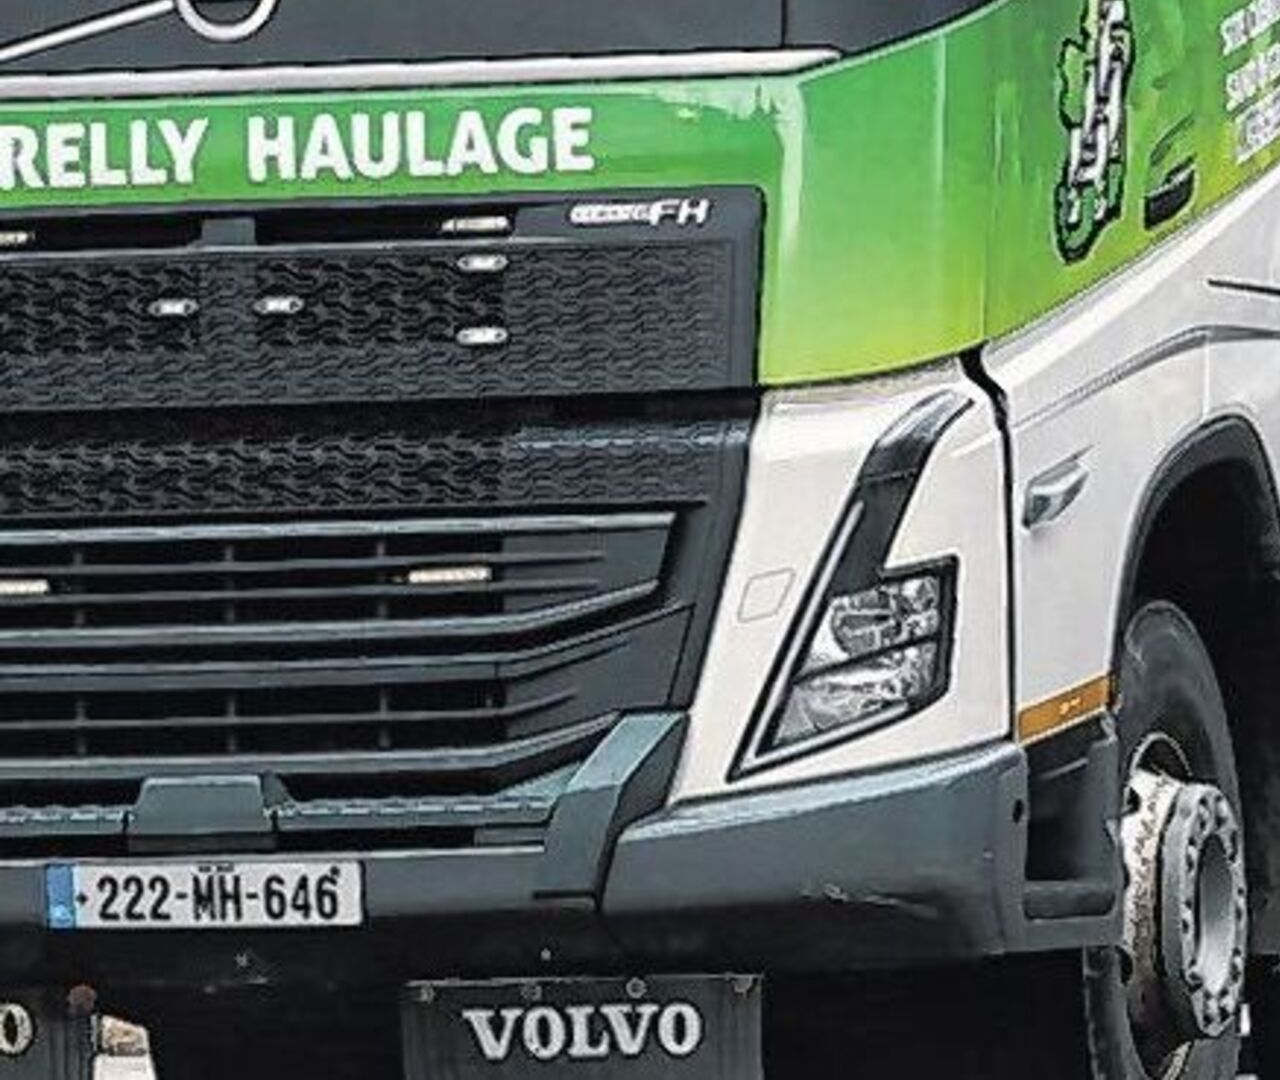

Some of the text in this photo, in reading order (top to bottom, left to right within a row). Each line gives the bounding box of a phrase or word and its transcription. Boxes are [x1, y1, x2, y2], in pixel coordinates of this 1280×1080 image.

[248, 107, 595, 183] HAULAGE
[97, 872, 339, 921] 222-MH-646
[463, 1003, 702, 1060] VOLVO
